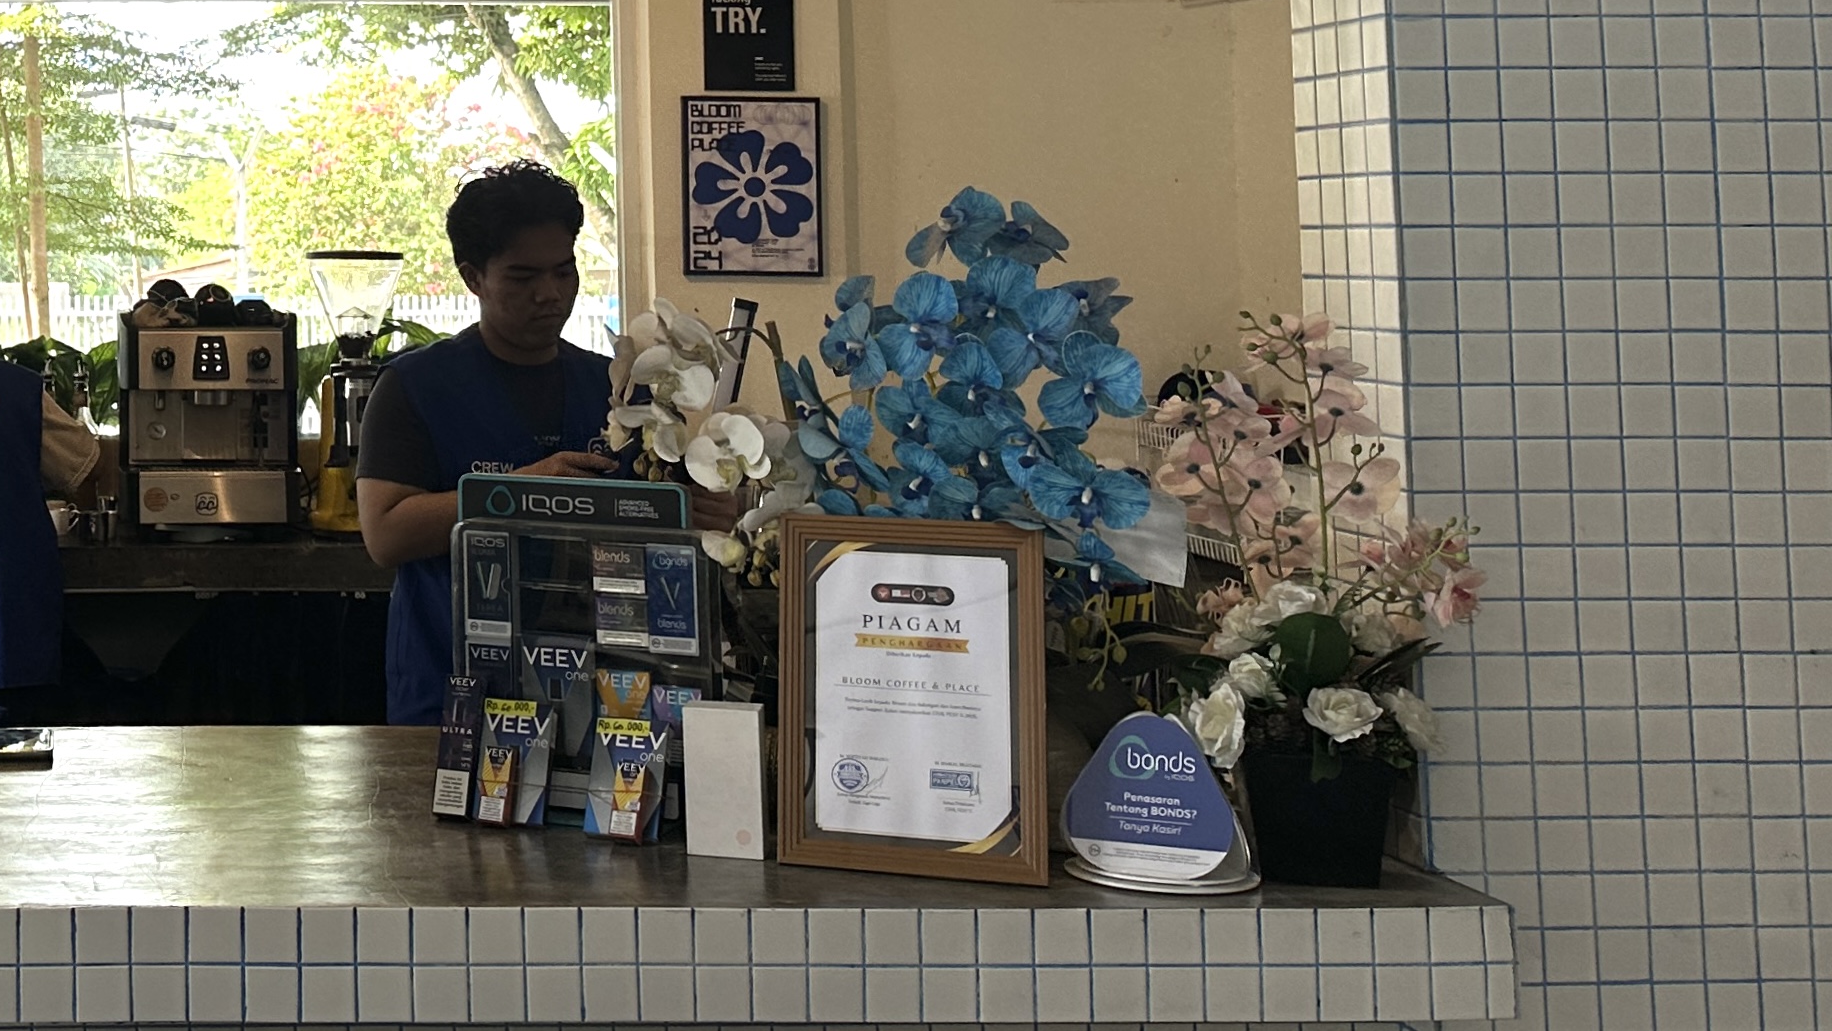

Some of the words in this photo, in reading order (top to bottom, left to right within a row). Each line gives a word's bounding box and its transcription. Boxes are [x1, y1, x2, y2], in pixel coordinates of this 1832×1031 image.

[710, 6, 766, 34] TRY.
[690, 104, 741, 118] BLOOM
[691, 121, 746, 135] COFFEE
[693, 250, 723, 270] 24
[471, 461, 514, 474] CREW
[521, 493, 596, 516] IQOS
[470, 536, 505, 548] IQOS
[593, 549, 630, 564] blends
[597, 601, 634, 616] blends
[862, 614, 962, 634] PIAGAM
[470, 645, 510, 661] VEEV
[522, 646, 588, 669] VEEV
[450, 676, 477, 687] VEEV
[565, 671, 589, 682] one
[597, 672, 647, 690] VEEV
[842, 676, 881, 687] BLOOM
[886, 679, 928, 689] COFFEE
[932, 682, 940, 690] &
[945, 683, 981, 693] PLACE
[653, 688, 702, 705] VEEV
[442, 726, 473, 735] ULTRA
[486, 713, 550, 736] VEEV
[524, 737, 549, 749] one
[600, 731, 666, 750] VEEV
[485, 745, 513, 757] VEEV
[640, 752, 665, 763] one
[616, 761, 646, 772] VEEV
[1127, 747, 1196, 774] bonds
[1123, 791, 1181, 806] Penasaran
[1104, 801, 1149, 817] Tentang
[1150, 806, 1198, 820] BONDS?
[1119, 820, 1150, 834] Tanya
